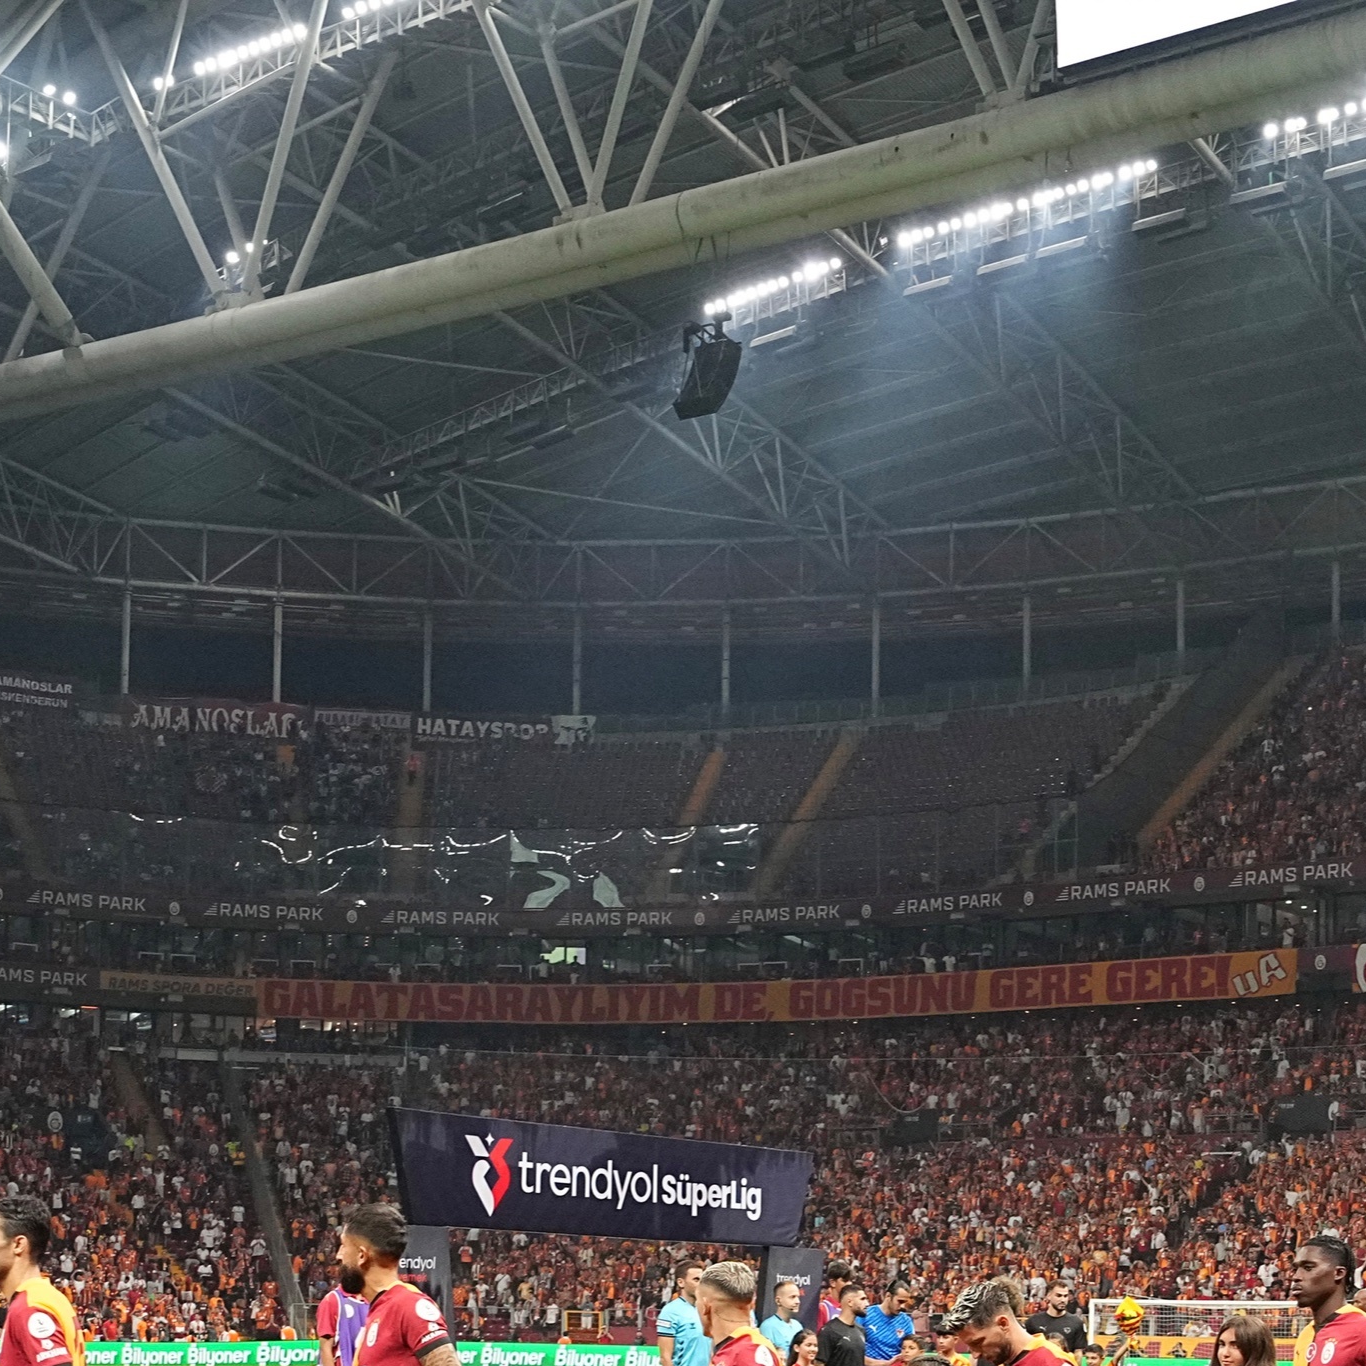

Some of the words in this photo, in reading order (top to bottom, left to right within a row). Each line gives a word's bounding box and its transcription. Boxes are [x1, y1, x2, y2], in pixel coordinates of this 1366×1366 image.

[1245, 866, 1297, 887] RAMS
[1303, 861, 1354, 881] PARK
[1071, 881, 1121, 901] RAMS
[1125, 877, 1172, 896] PARK
[42, 890, 94, 909] RAMS
[98, 895, 146, 912] PARK
[219, 902, 271, 919] RAMS
[276, 905, 324, 921] PARK
[906, 896, 955, 914] RAMS
[959, 892, 1003, 911] PARK
[396, 910, 448, 926] RAMS
[452, 911, 501, 926] PARK
[572, 911, 622, 926] RAMS
[627, 911, 673, 926] PARK
[742, 907, 791, 923] RAMS
[795, 904, 840, 921] PARK
[40, 970, 88, 987] PARK
[108, 976, 148, 991] RAMS
[152, 979, 201, 994] SPORA
[205, 981, 254, 998] DEĞER
[988, 964, 1094, 1009] GERE
[1105, 954, 1234, 1003] GERE!
[518, 1151, 659, 1210] trendyol
[121, 1343, 184, 1366] Bilyoner
[188, 1343, 251, 1366] Bilyoner
